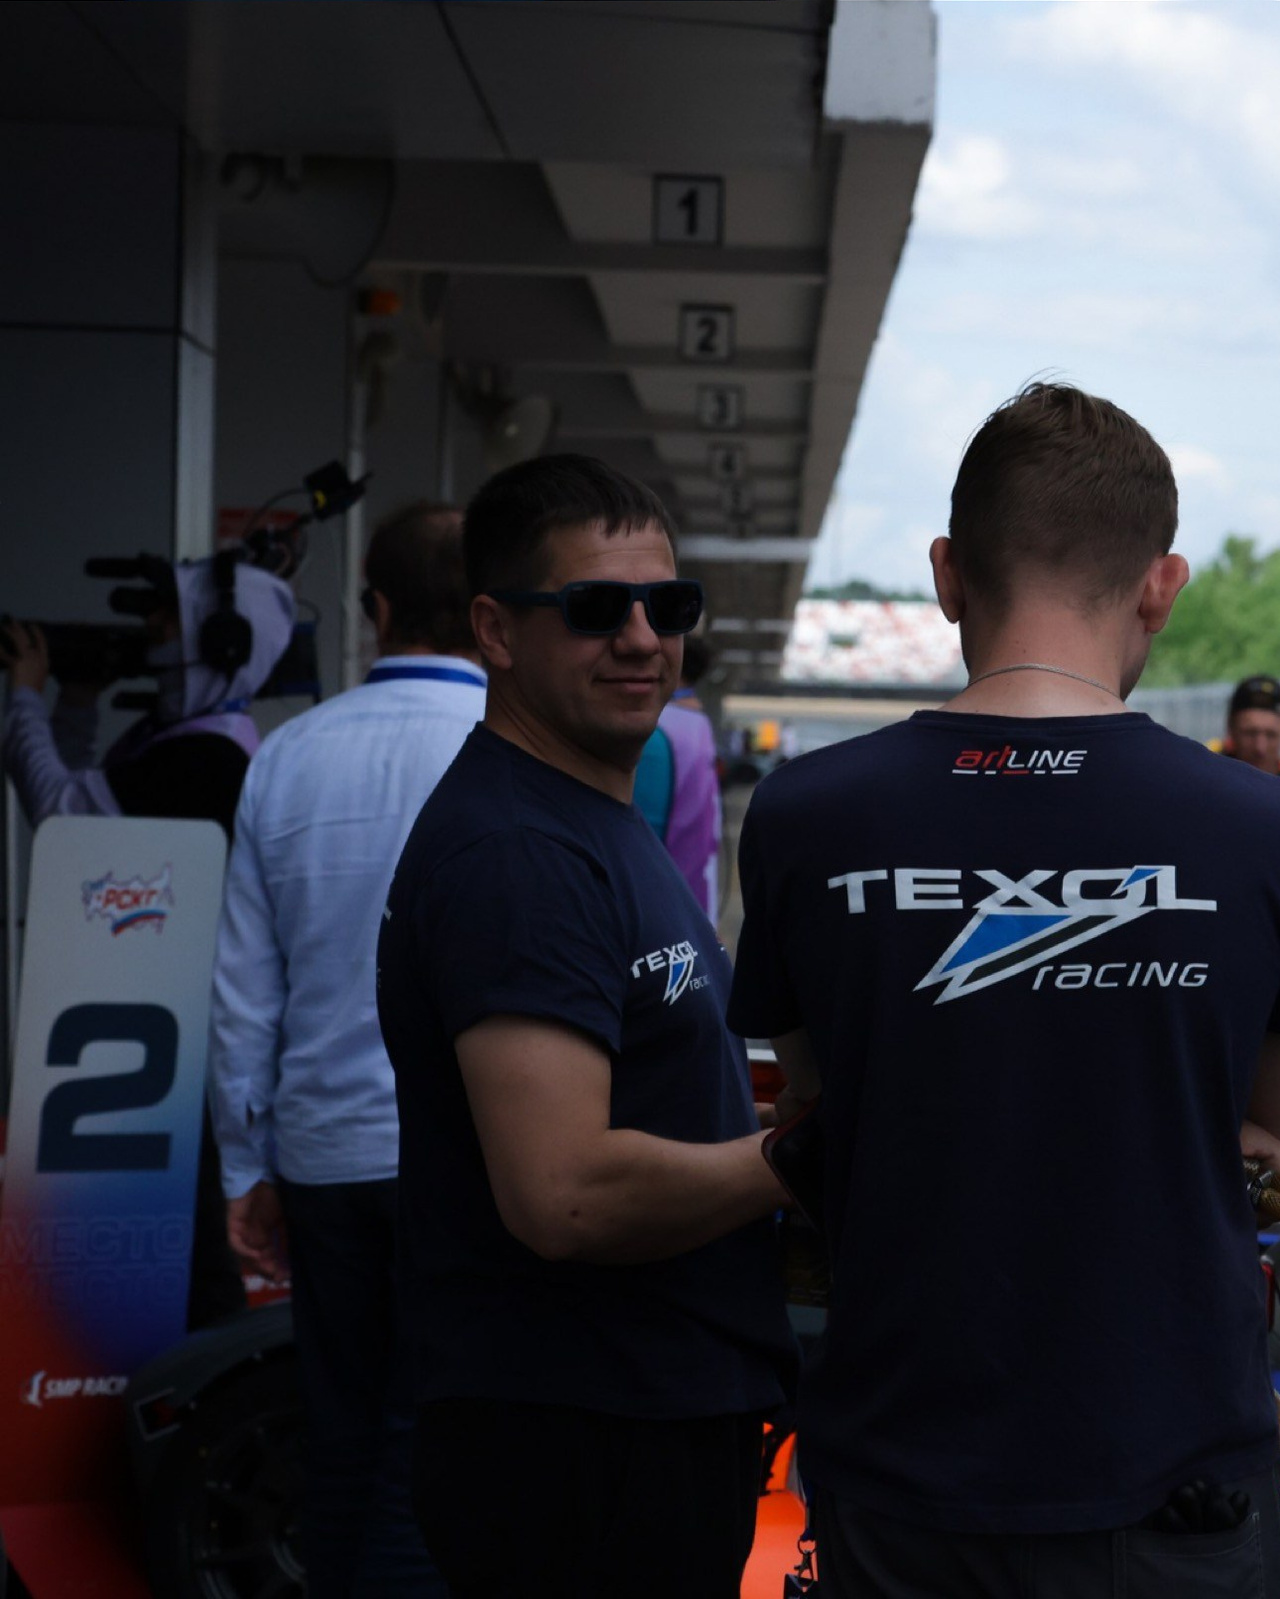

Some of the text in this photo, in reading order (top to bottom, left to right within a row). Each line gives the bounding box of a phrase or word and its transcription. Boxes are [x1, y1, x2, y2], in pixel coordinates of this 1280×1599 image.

[677, 188, 699, 236] 1
[696, 316, 718, 353] 2
[953, 744, 1088, 771] artLINE
[36, 1002, 179, 1173] 2
[44, 1377, 82, 1400] SMP
